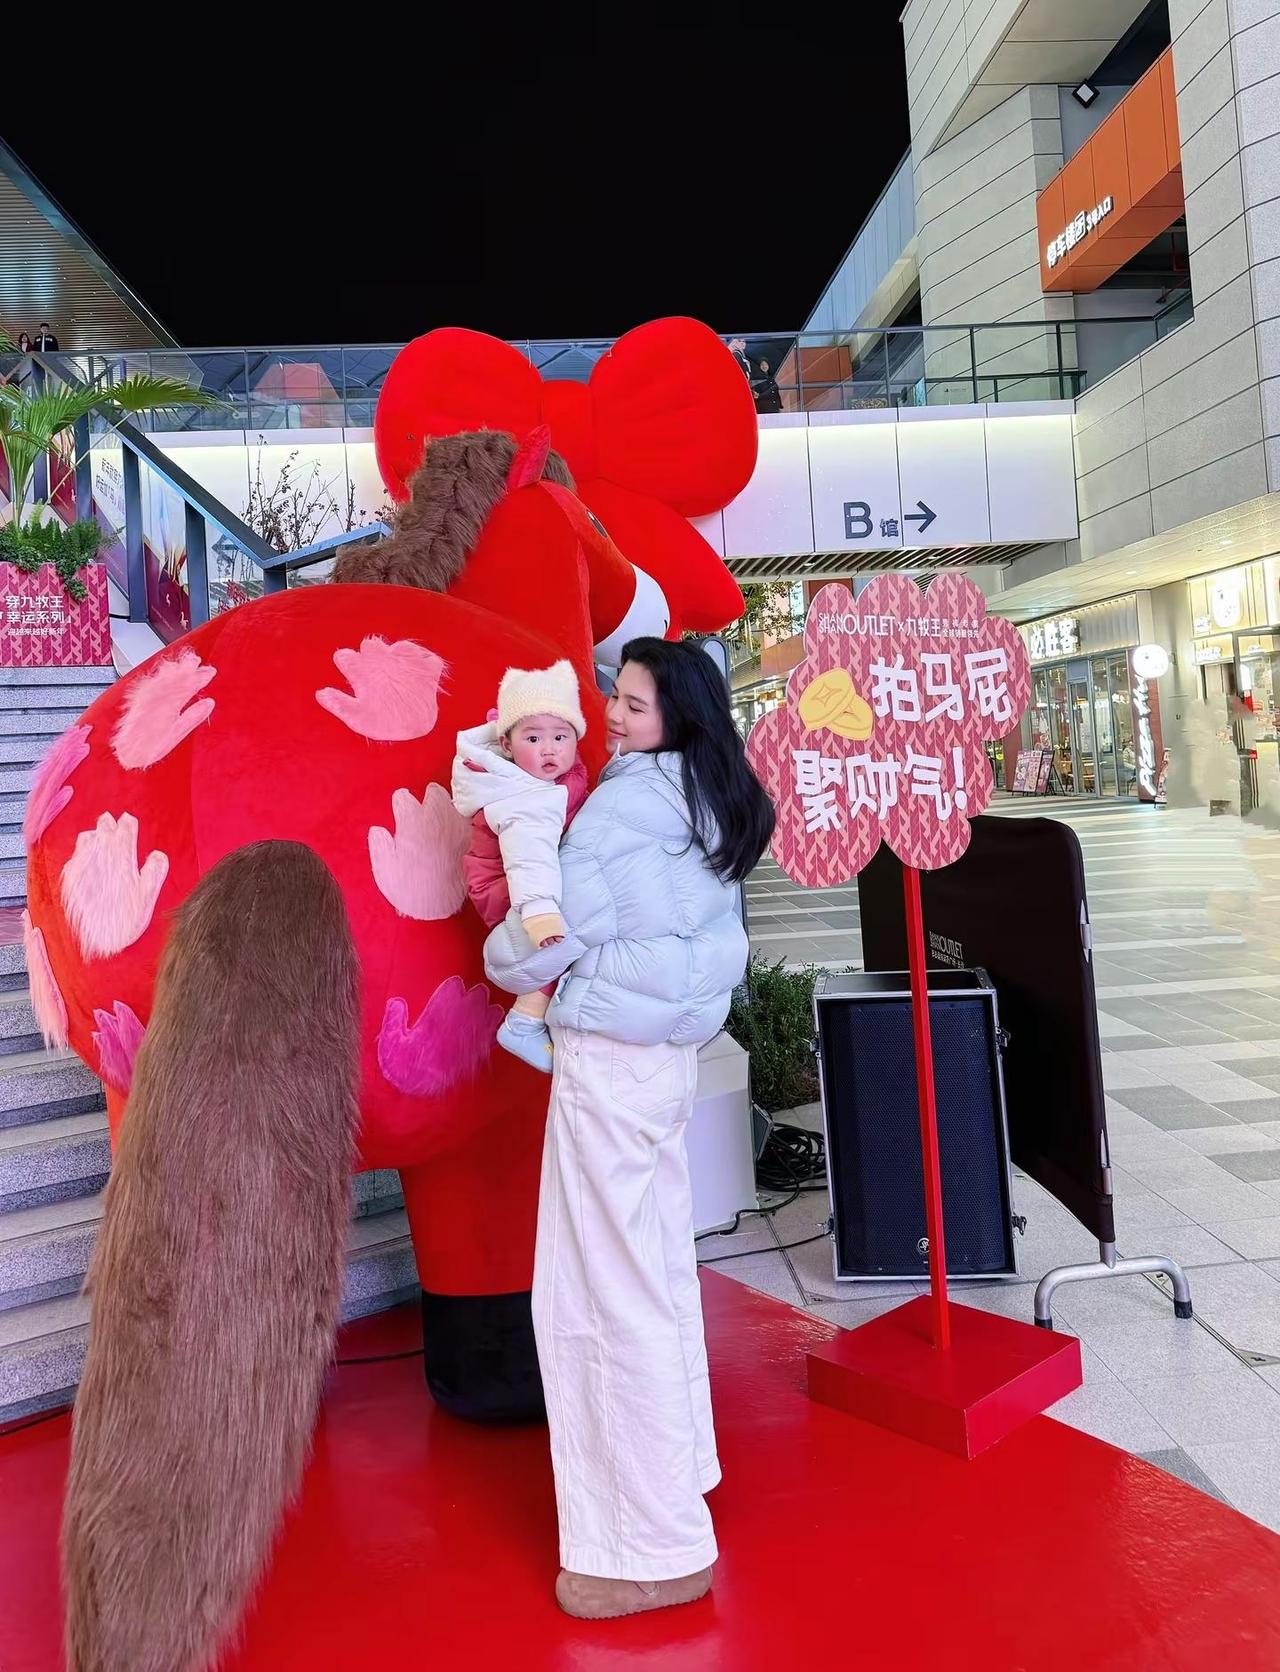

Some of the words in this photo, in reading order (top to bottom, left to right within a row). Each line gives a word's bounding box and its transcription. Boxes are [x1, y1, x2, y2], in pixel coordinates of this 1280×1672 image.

[5, 595, 65, 609] 穿九牧王
[818, 612, 844, 623] SHAN
[843, 614, 896, 636] OUTLET
[906, 617, 942, 637] 九牧王
[818, 624, 844, 634] SHAN
[869, 647, 1014, 723] 拍马屁
[792, 745, 969, 834] 聚财气!
